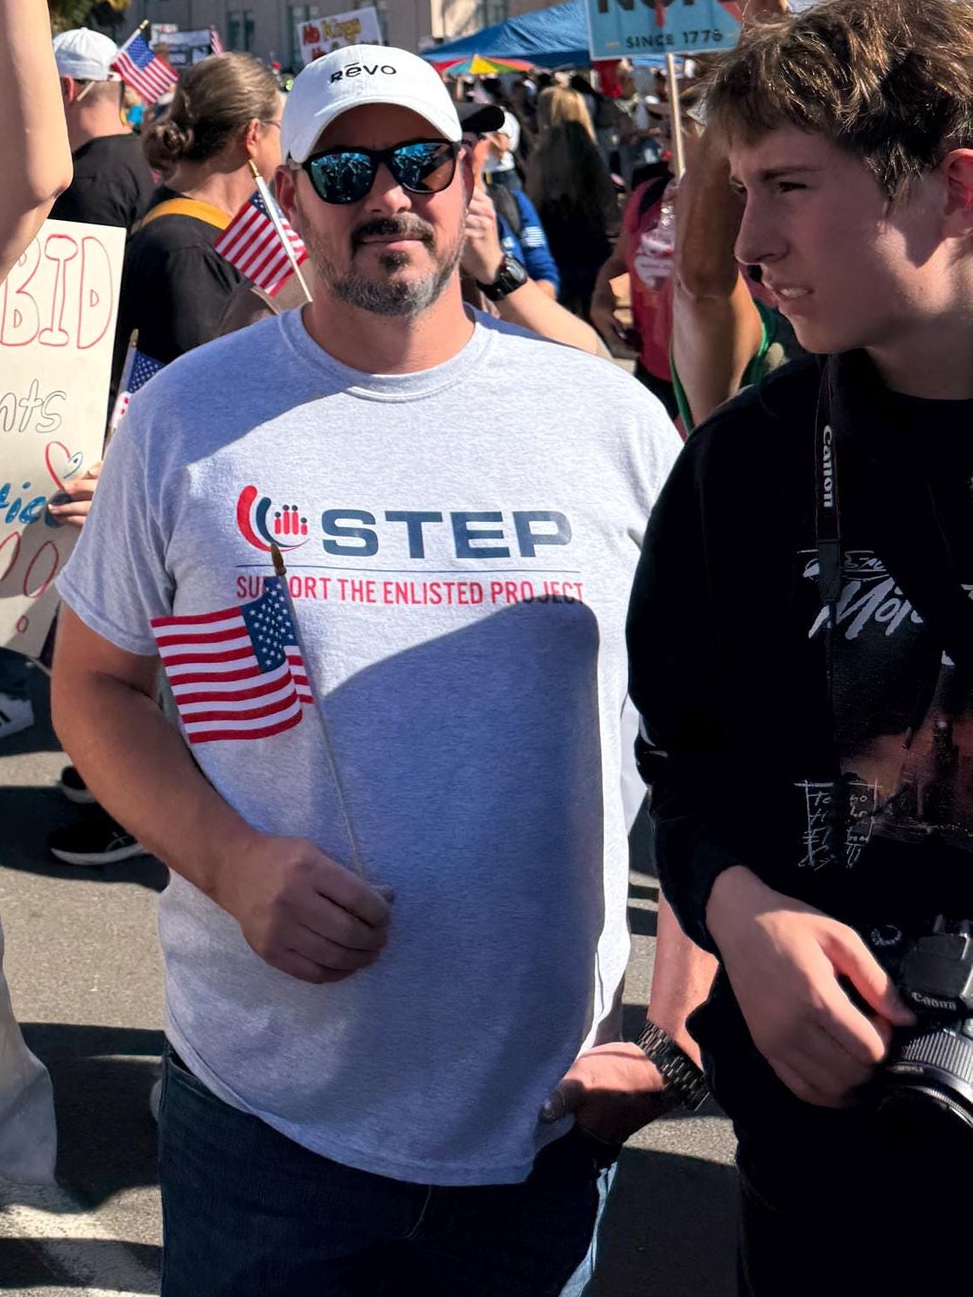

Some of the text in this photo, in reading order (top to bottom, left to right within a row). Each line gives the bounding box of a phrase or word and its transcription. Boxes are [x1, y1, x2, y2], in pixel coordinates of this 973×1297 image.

[625, 33, 674, 49] SINCE
[823, 424, 833, 508] Canon
[321, 508, 573, 559] STEP
[236, 575, 584, 605] SUORT THE ENLISTED PROJECT
